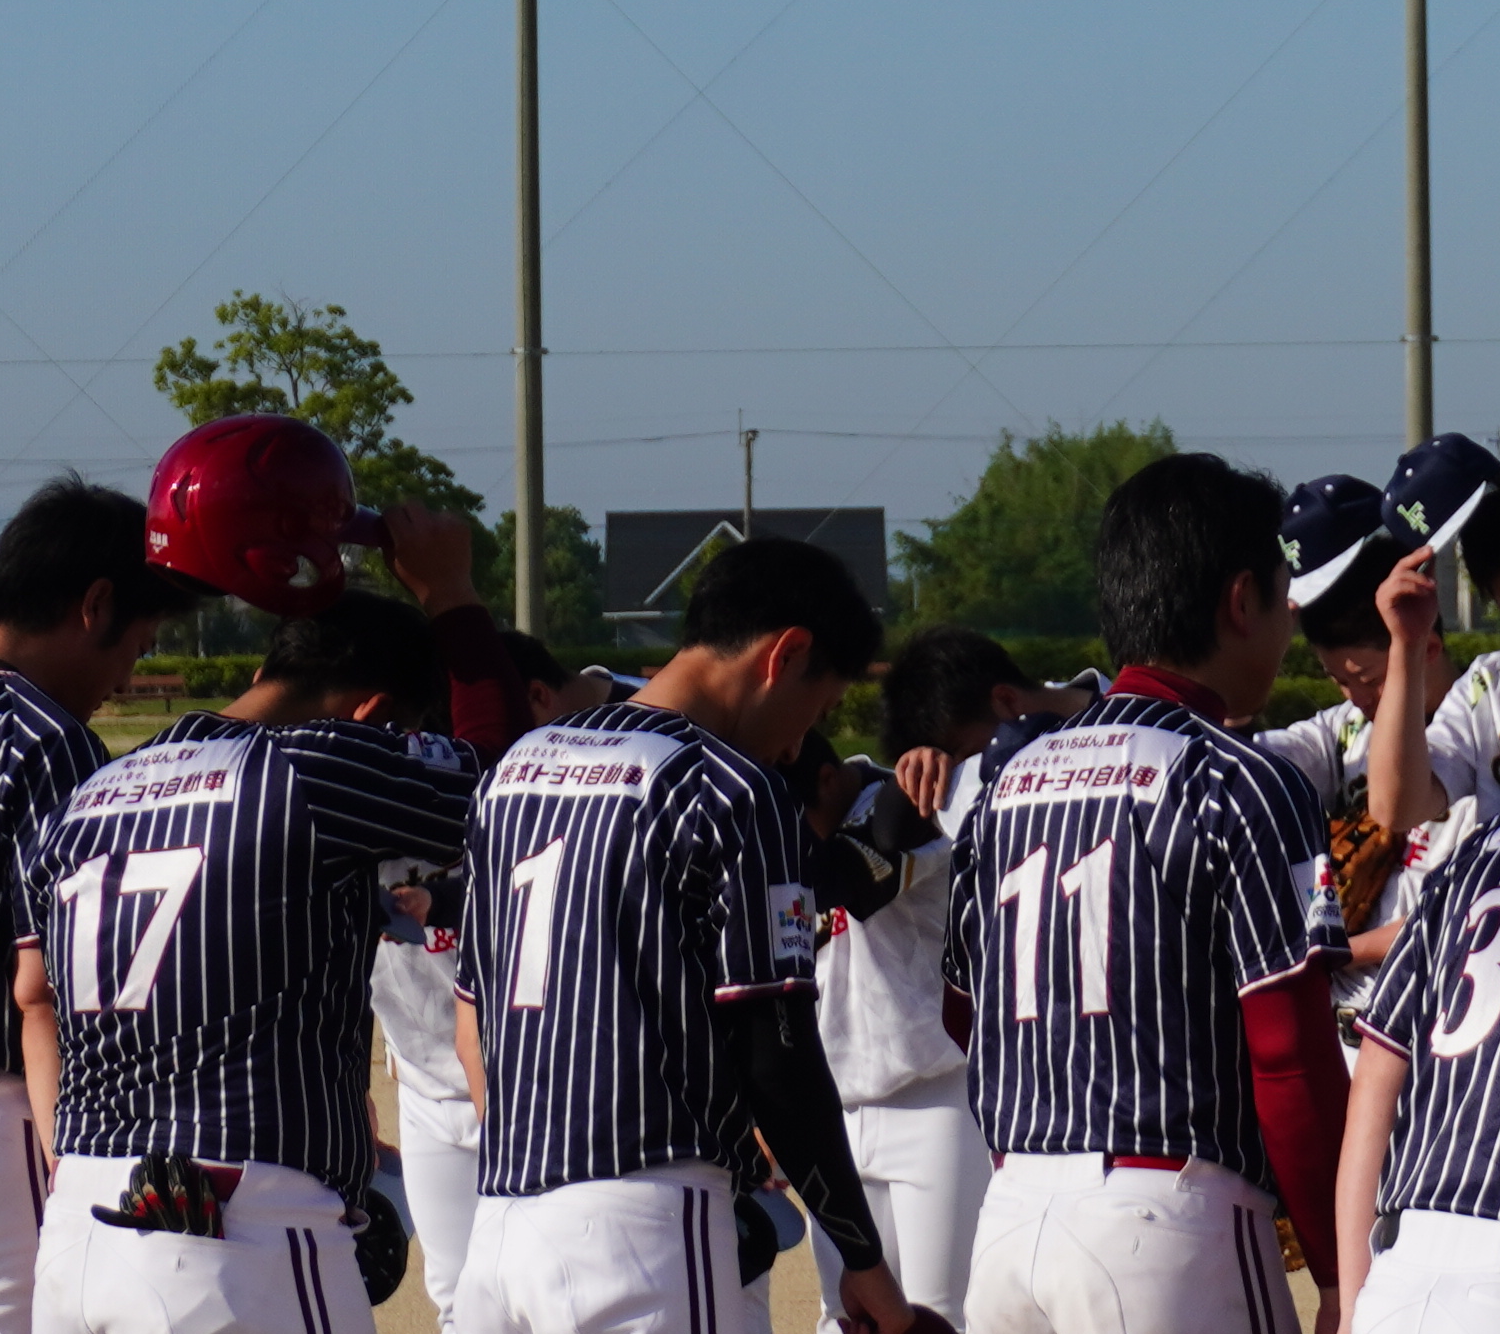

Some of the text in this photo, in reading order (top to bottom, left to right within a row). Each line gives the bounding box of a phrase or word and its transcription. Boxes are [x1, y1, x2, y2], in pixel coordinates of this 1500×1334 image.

[56, 845, 206, 1013] 17
[510, 836, 566, 1010] 1
[997, 836, 1115, 1021] 11
